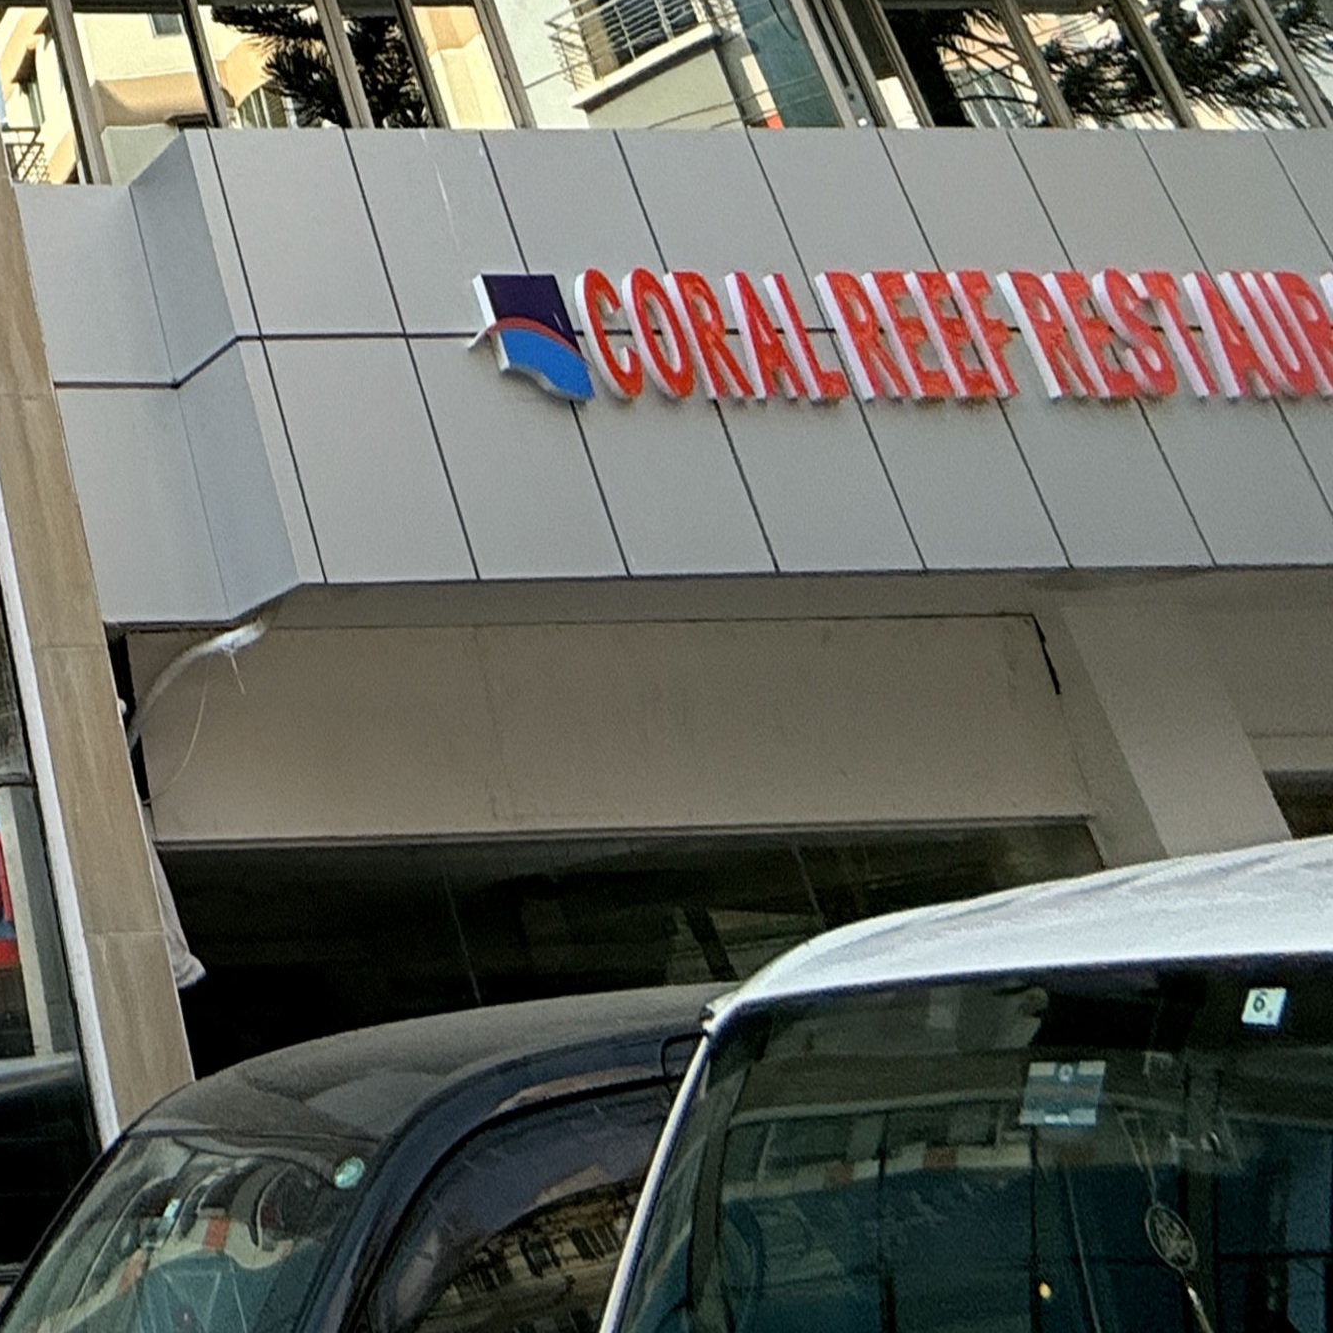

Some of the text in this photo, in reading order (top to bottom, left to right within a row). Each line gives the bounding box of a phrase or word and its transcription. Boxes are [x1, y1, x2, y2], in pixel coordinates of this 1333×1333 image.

[576, 268, 1333, 402] CORAL REEF RESTAUR
